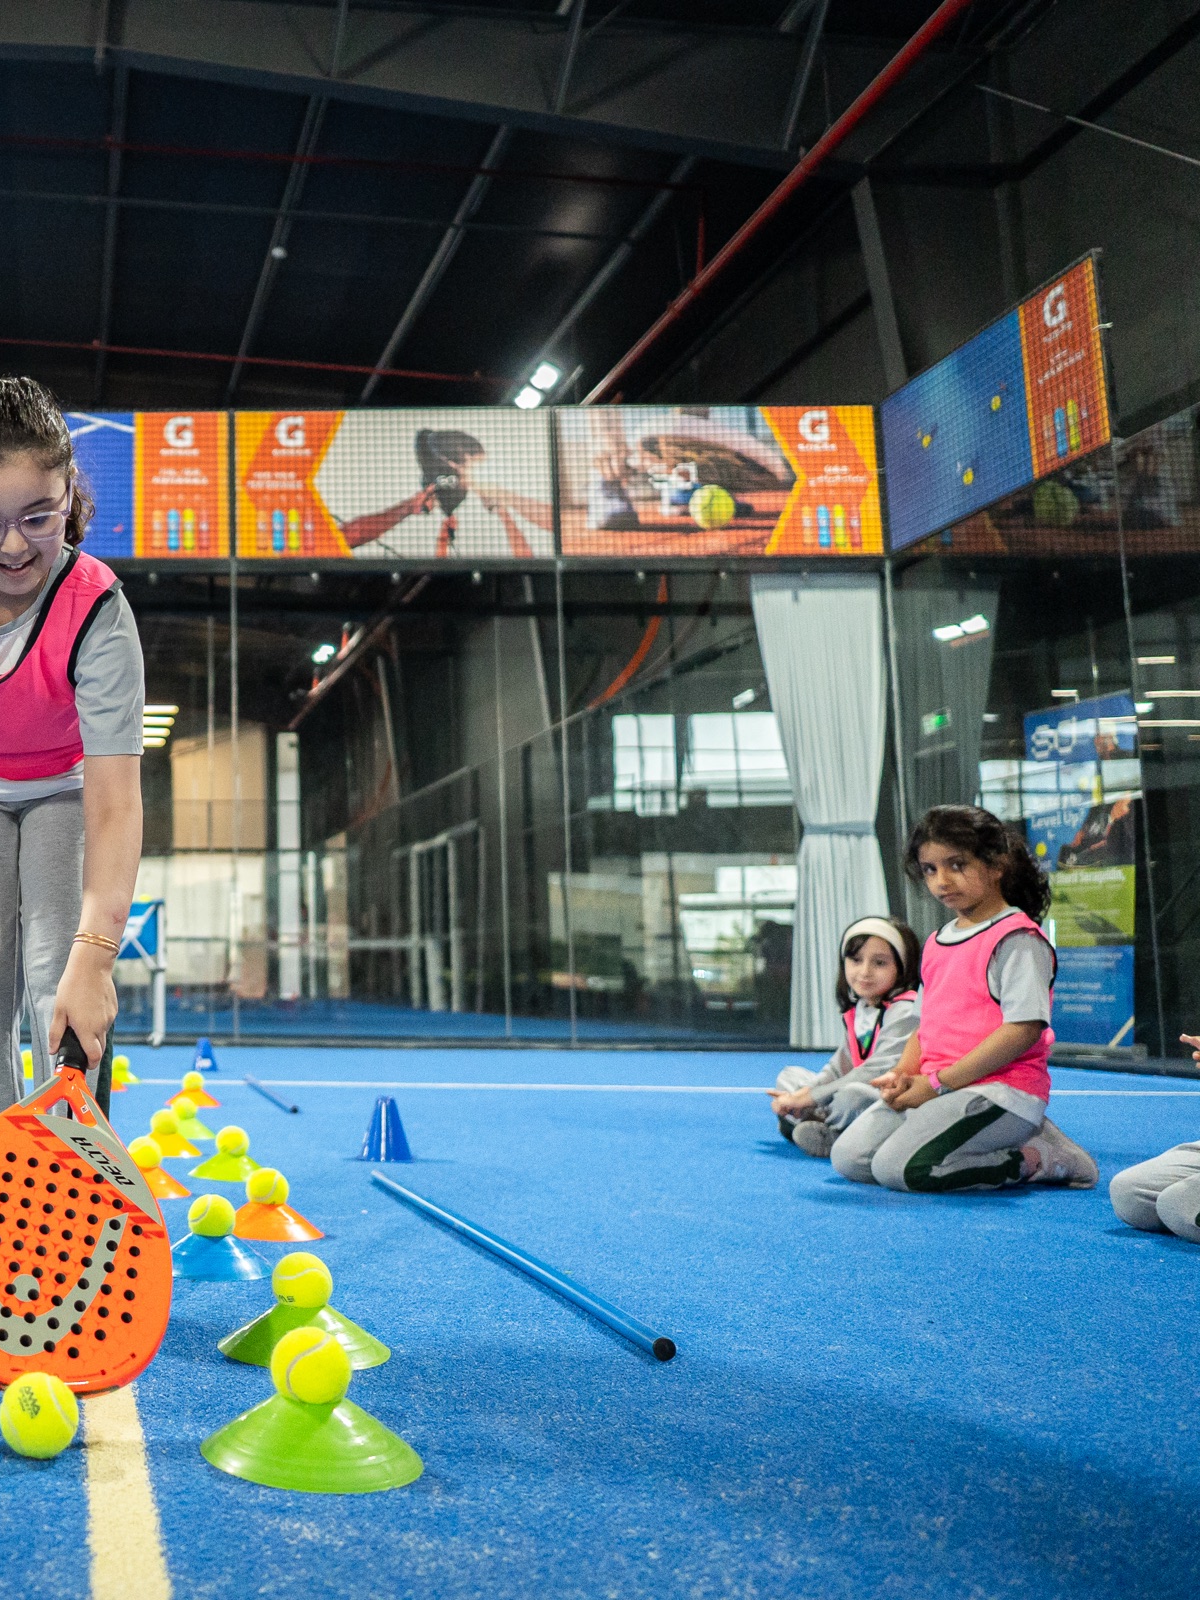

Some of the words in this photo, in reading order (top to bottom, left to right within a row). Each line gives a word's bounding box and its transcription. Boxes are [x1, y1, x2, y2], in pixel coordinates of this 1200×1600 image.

[1043, 282, 1066, 328] G
[163, 415, 194, 449] G
[275, 415, 305, 448] G
[798, 409, 829, 442] G
[69, 1136, 136, 1186] DELTA
